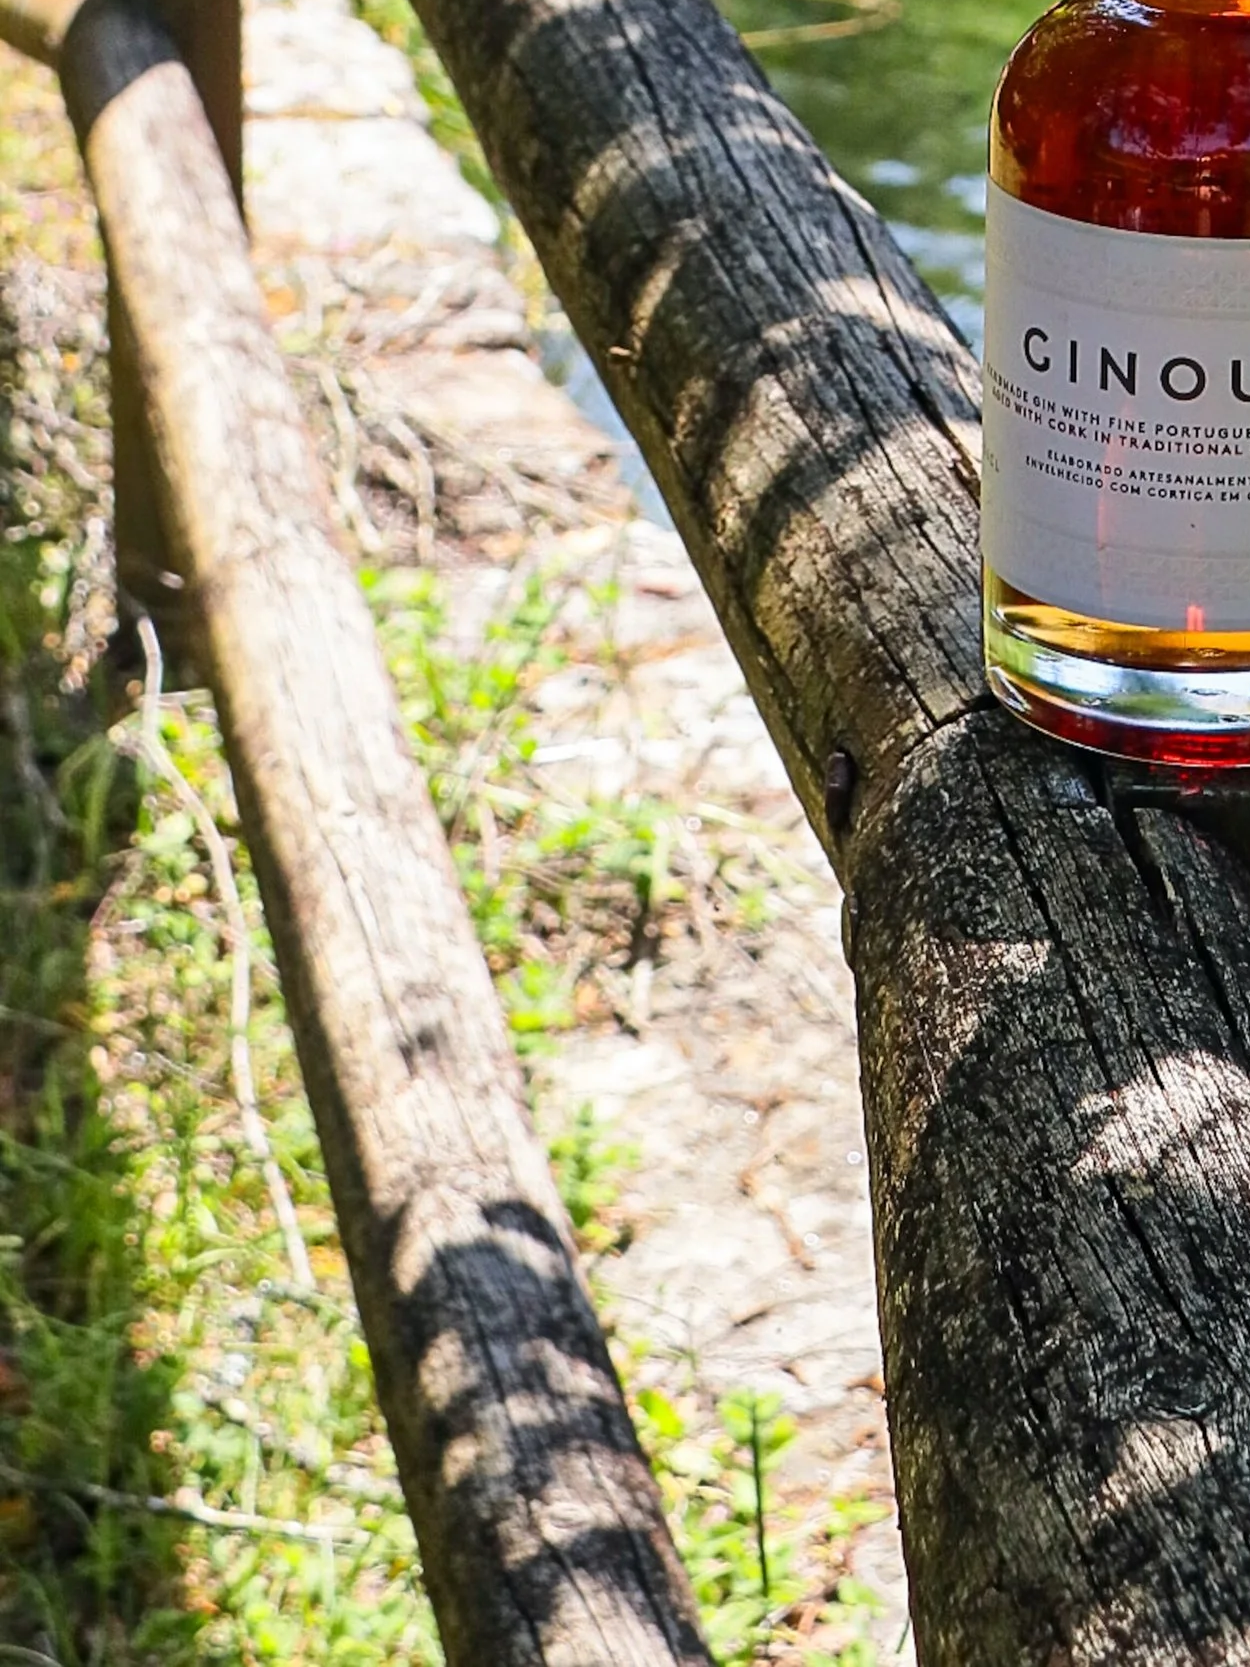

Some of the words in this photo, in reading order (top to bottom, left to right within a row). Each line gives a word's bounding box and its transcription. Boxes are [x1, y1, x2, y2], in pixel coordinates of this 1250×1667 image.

[1014, 402, 1042, 425] WITH
[1048, 418, 1087, 439] CORK
[1094, 430, 1111, 444] IN
[1119, 435, 1243, 455] TRADITIONAL
[1033, 396, 1056, 413] GIN
[1062, 405, 1100, 425] WITH
[1109, 417, 1146, 433] FINE
[1026, 455, 1104, 488] ENVELHECIDO
[1110, 482, 1141, 495] COM
[1147, 487, 1214, 502] CORTIÇA
[1220, 492, 1240, 502] EM
[1047, 449, 1122, 477] ELABORADO
